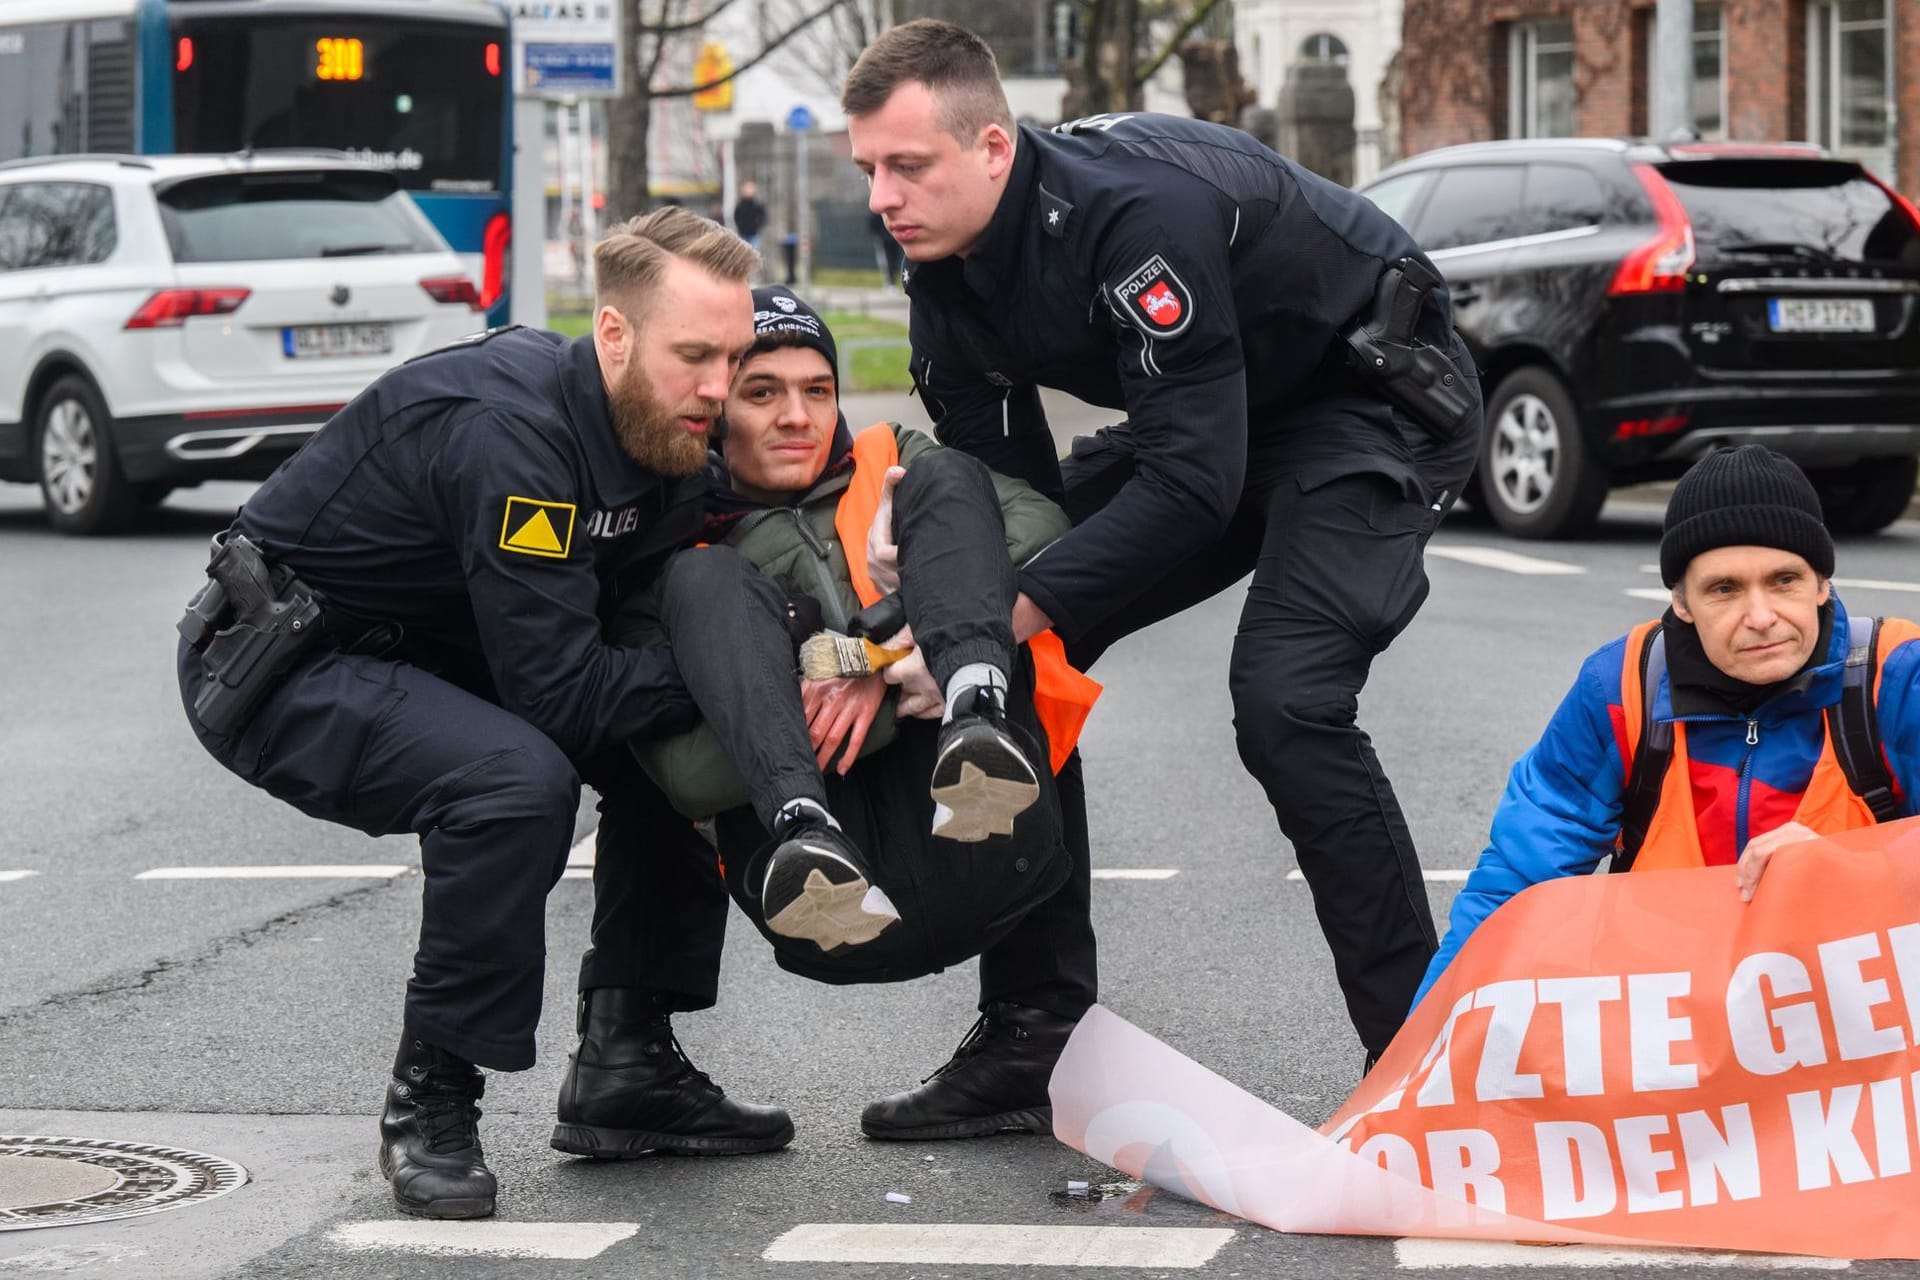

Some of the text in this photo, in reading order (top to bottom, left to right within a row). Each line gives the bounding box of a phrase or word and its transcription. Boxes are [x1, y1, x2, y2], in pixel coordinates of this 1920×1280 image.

[316, 37, 363, 80] 300
[1121, 261, 1164, 301] POLIZEI
[1340, 1070, 1920, 1225] OR DEN KI
